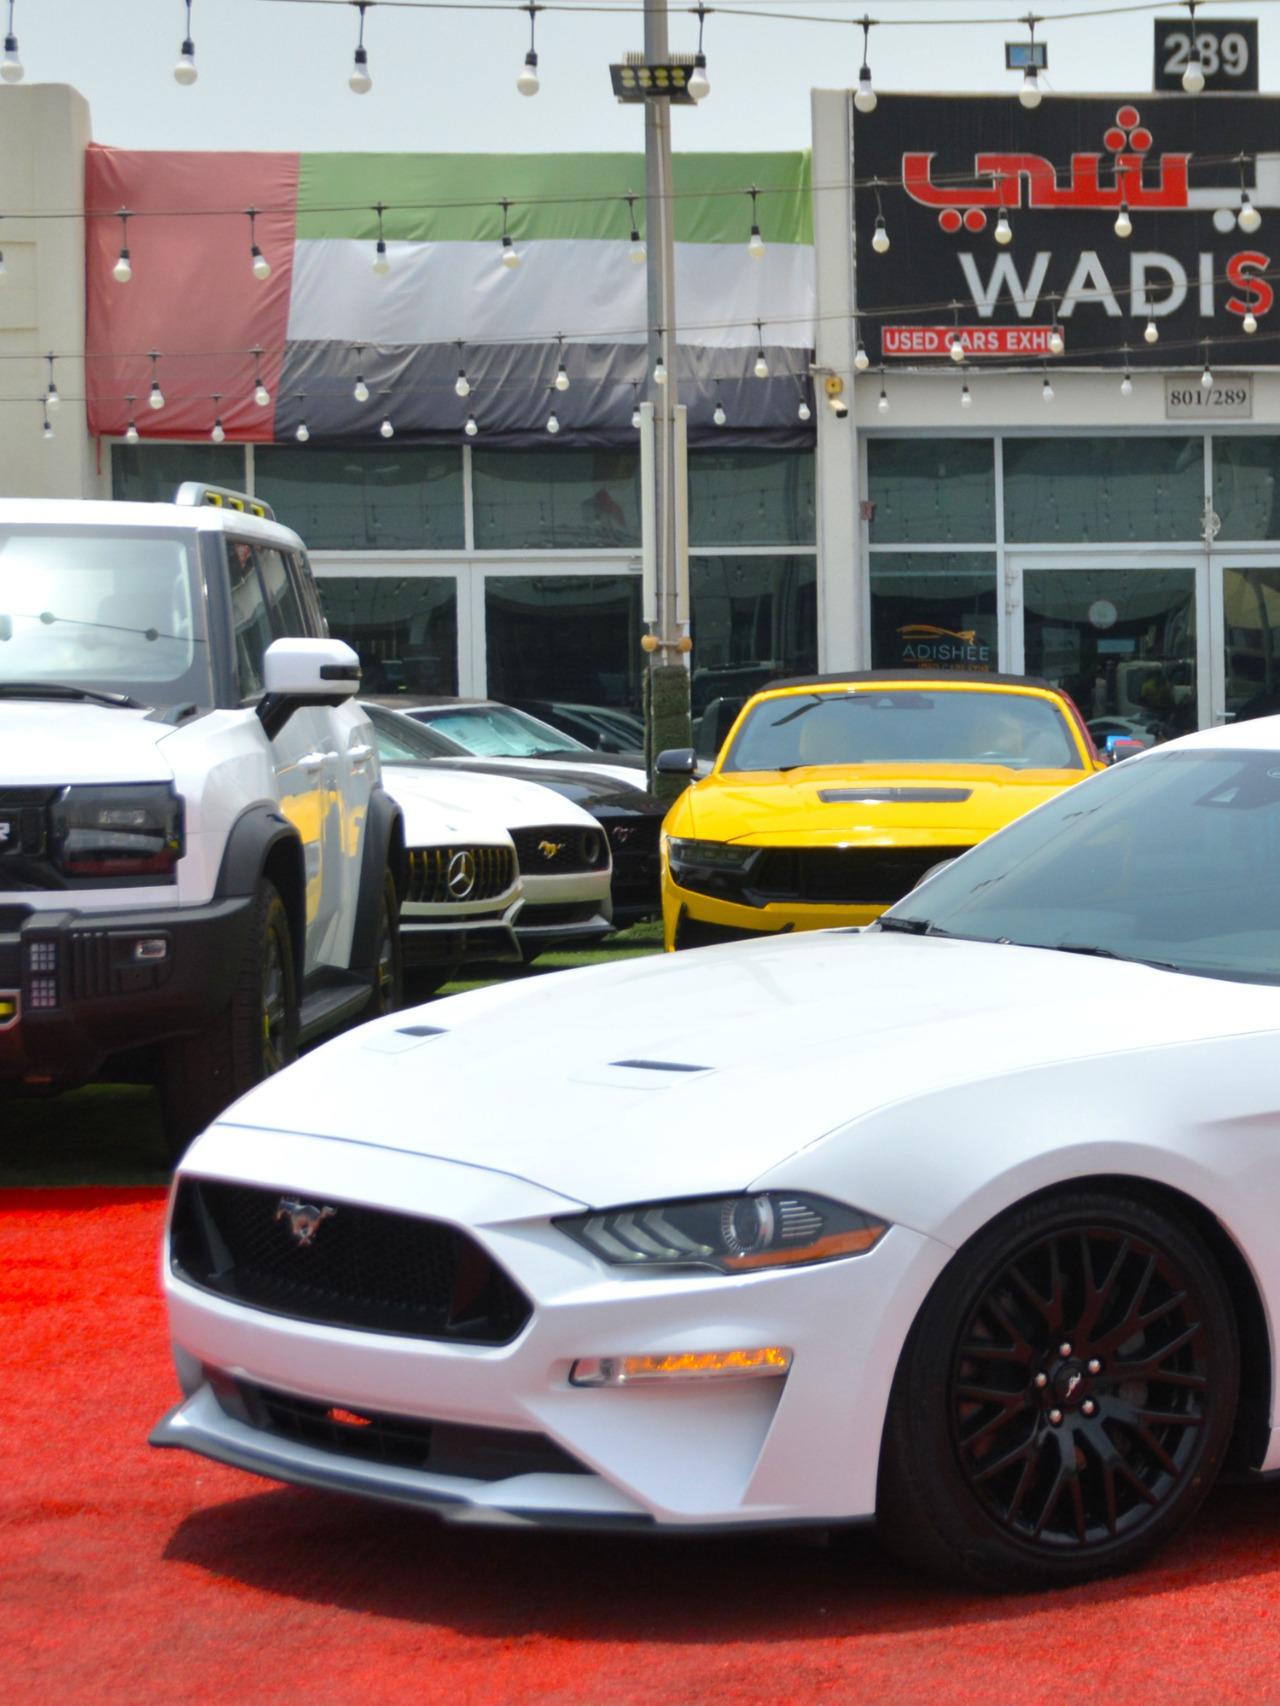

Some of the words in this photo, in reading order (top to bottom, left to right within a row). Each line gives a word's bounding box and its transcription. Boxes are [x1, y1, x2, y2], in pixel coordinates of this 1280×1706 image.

[1163, 32, 1249, 76] 289
[885, 332, 938, 350] USED
[1170, 389, 1247, 407] 801/289
